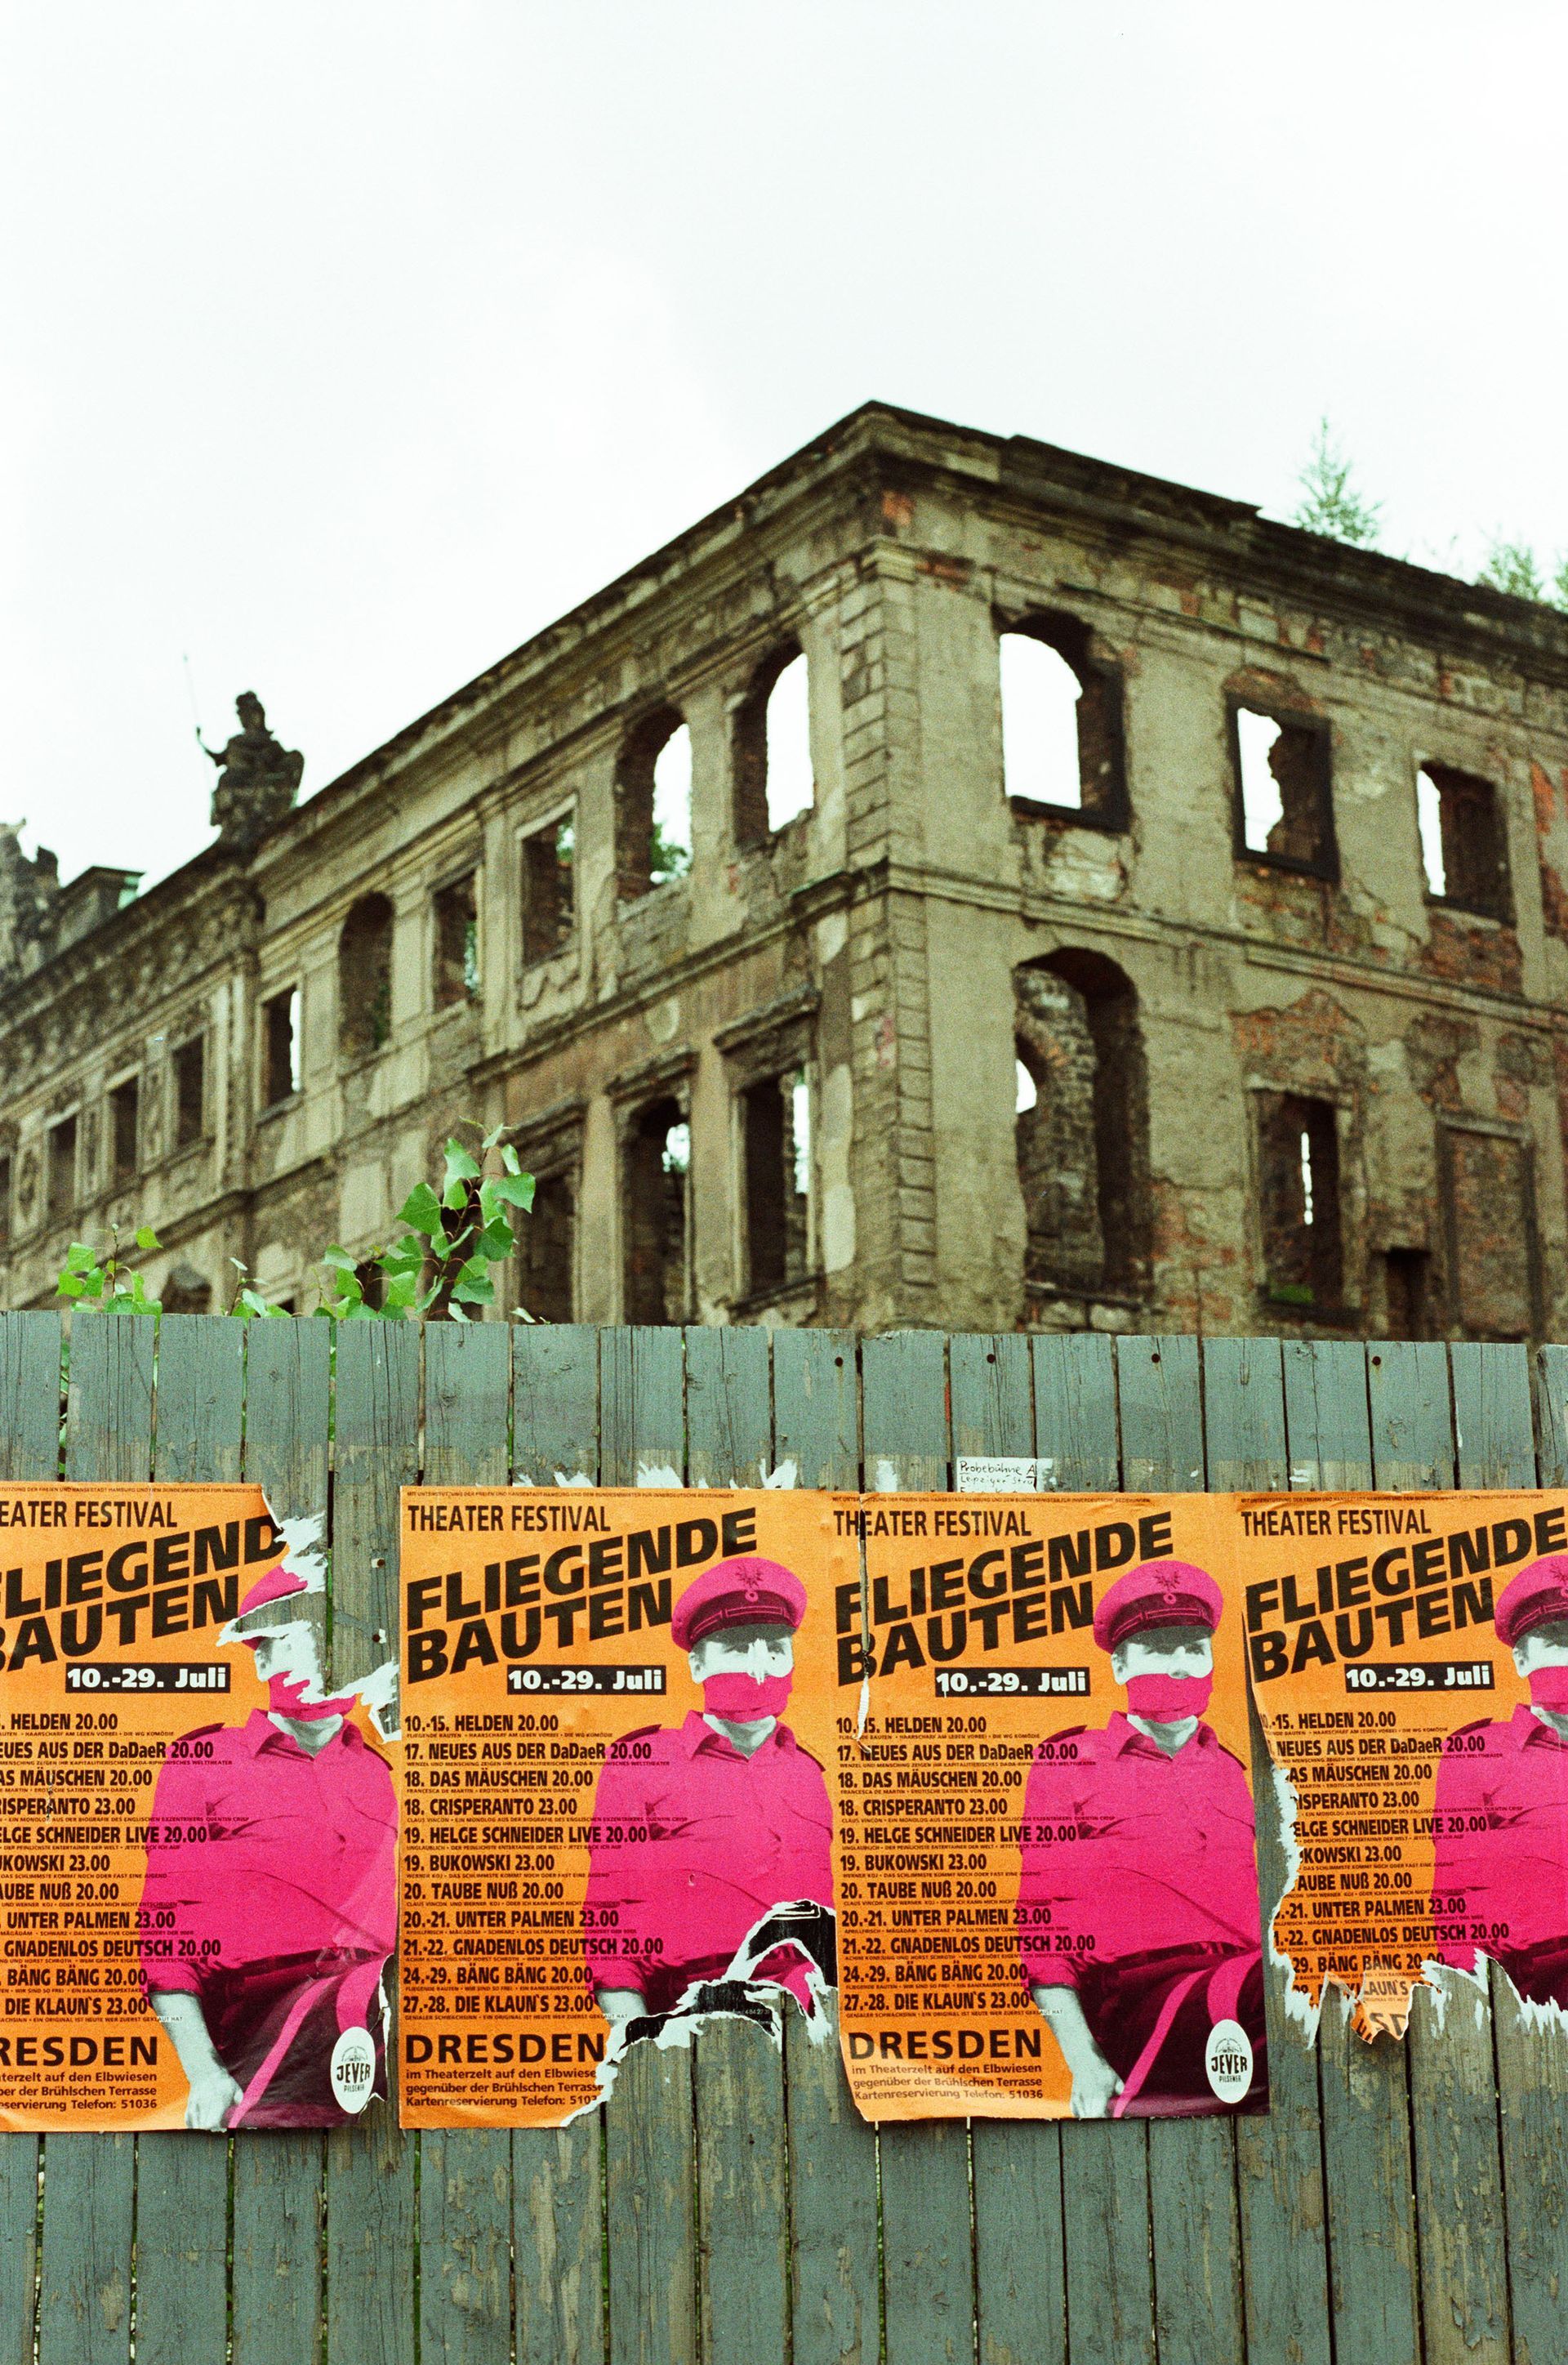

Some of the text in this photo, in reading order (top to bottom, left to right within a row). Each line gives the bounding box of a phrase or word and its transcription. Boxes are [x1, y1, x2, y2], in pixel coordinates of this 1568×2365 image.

[75, 1502, 177, 1527] FESTIVAL
[408, 1506, 610, 1532] THEATER FESTIVAL
[834, 1509, 1031, 1537] THEATER FESTIVAL
[1241, 1510, 1431, 1536] THEATER FESTIVAL
[0, 1515, 287, 1619] LIEGEND
[407, 1507, 757, 1631] FLIEGENDE
[835, 1510, 1174, 1635] FLIEGENDE
[1245, 1506, 1568, 1633] FLIEGENDE
[0, 1574, 238, 1671] AUTEN
[408, 1577, 673, 1685] BAUTEN
[1249, 1577, 1494, 1683] BAUTEN
[838, 1581, 1094, 1686] BAUTEN
[67, 1668, 226, 1689] 10.-29. Juli
[508, 1670, 662, 1690] 10.-29. Juli
[936, 1671, 1085, 1693] 10.-29. Juli
[1346, 1666, 1490, 1688] 10.-29. Juli
[11, 1713, 118, 1729] HELDEN 20.00
[405, 1715, 558, 1731] 10.-15. HELDEN 20.00
[1298, 1711, 1396, 1729] HELDEN 20.00
[38, 1742, 68, 1758] AUS
[74, 1742, 103, 1758] DER
[109, 1742, 166, 1758] DaDaeR
[172, 1740, 213, 1758] 20.00
[405, 1741, 651, 1760] 17. NEUES AUS DER DaDaeR 20.00
[405, 1768, 593, 1787] 18. DAS MÄUSCHEN 20.00
[1285, 1762, 1432, 1783] AS MÄUSCHEN 20.00
[405, 1798, 577, 1815] 18. CRISPERANTO 23.00
[0, 1827, 207, 1843] LGE SCHNEIDER LIVE 20.00
[405, 1827, 647, 1843] 19. HELGE SCHNEIDER LIVE 20.00
[404, 1854, 555, 1871] 19. BUKOWSKI 23.00
[840, 1854, 987, 1871] 19. BUKOWSKI 23.00
[404, 1881, 564, 1899] 20. TAUBE NUß 20.00
[842, 1908, 1051, 1926] 20.-21. UNTER PALMEN 23.00
[1313, 1898, 1466, 1918] UNTER PALMEN 23.00
[7, 1912, 175, 1928] UNTER PALMEN 23.00
[843, 1935, 1095, 1954] 21.-22. GNADENLOS DEUTSCH 20.00
[1312, 1923, 1508, 1947] GNADENLOS DEUTSCH 20.00
[1318, 1951, 1401, 1972] BÄNG BÄNG
[403, 1963, 595, 1985] 24.-29. BÄNG BÄNG 20.00
[6, 1998, 29, 2015] DIE
[107, 1997, 149, 2015] 23.00
[844, 1993, 889, 2010] 27.-28.
[895, 1993, 918, 2010] DIE
[991, 1990, 1031, 2008] 23.00
[406, 2033, 604, 2063] DRESDEN
[849, 2028, 1041, 2060] DRESDEN
[336, 2063, 371, 2084] JEVER
[406, 2068, 421, 2079] im
[425, 2068, 491, 2079] Theaterzelt
[495, 2068, 514, 2079] auf
[519, 2068, 541, 2079] den
[1211, 2054, 1247, 2074] JEVER
[45, 2072, 65, 2082] auf
[69, 2073, 91, 2082] den
[96, 2072, 157, 2082] Elbwiesen
[20, 2086, 38, 2095] der
[42, 2086, 105, 2095] Brühlschen
[109, 2086, 156, 2095] Terrasse
[406, 2082, 466, 2095] gegenüber
[469, 2082, 488, 2093] der
[492, 2082, 554, 2093] Brühlschen
[71, 2099, 117, 2110] Telefon:
[121, 2099, 157, 2109] 51036
[406, 2095, 517, 2108] Kartenreservierung
[522, 2095, 565, 2106] Telefon:
